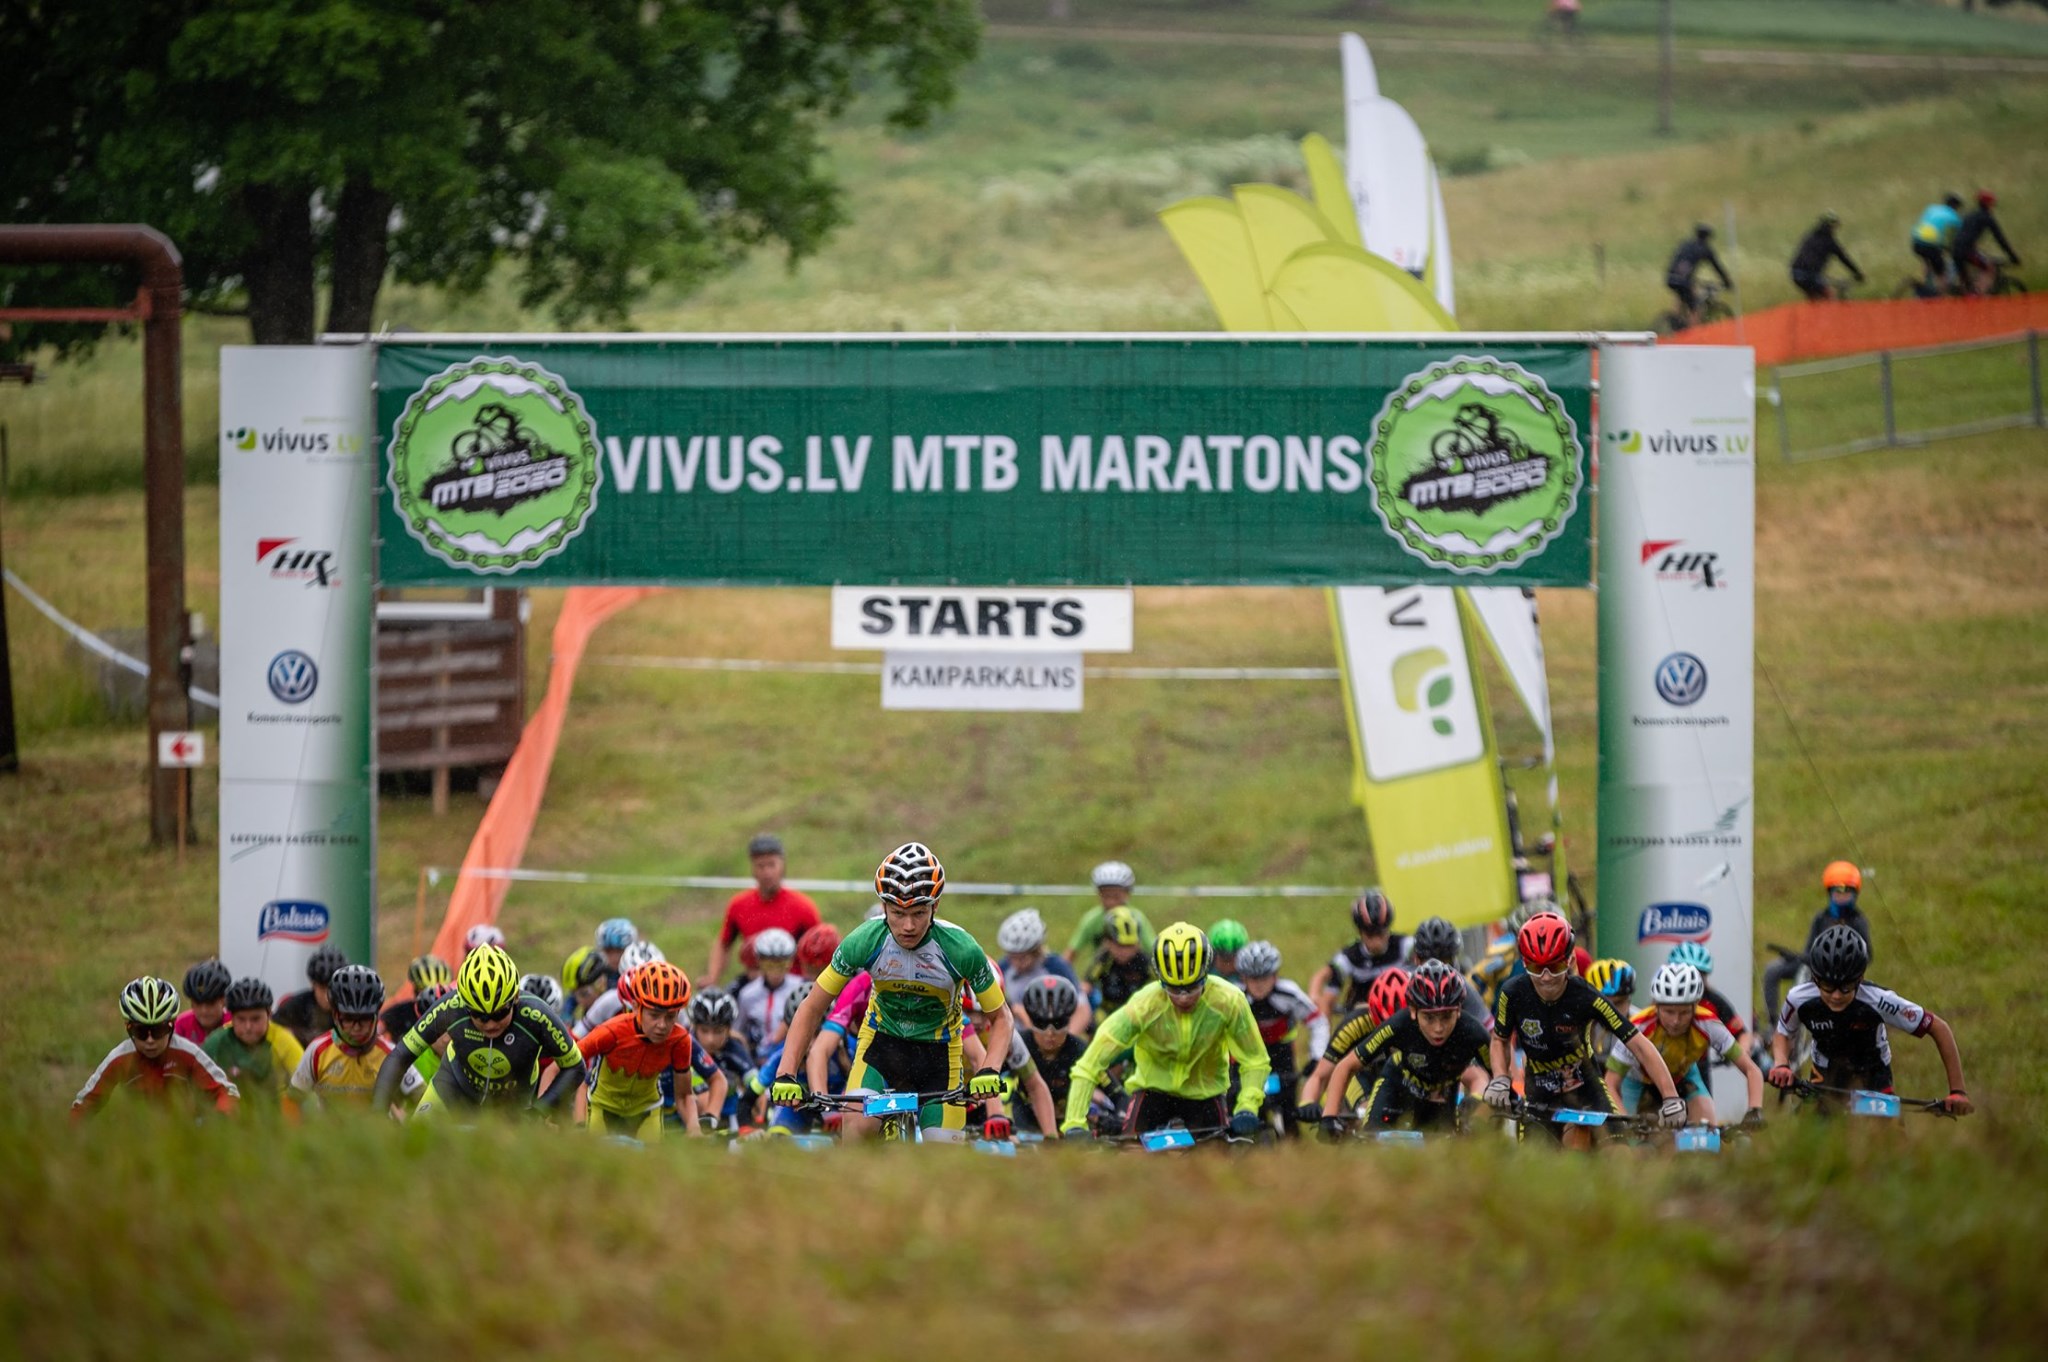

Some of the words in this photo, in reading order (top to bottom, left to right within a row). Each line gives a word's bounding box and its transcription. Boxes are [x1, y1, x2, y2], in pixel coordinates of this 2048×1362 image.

[604, 435, 871, 492] VIVUS.LV
[892, 435, 1019, 492] MTB
[1040, 435, 1363, 492] MARATONS
[432, 472, 495, 508] MTB
[493, 466, 567, 499] 2020
[1409, 472, 1474, 506] MTB
[1473, 467, 1547, 499] 2020
[861, 596, 1085, 637] STARTS
[890, 665, 1075, 688] KAMPARKALNS
[417, 994, 465, 1033] cervél
[1592, 996, 1624, 1031] HAWAII
[887, 1098, 898, 1111] 4
[1869, 1100, 1888, 1113] 12
